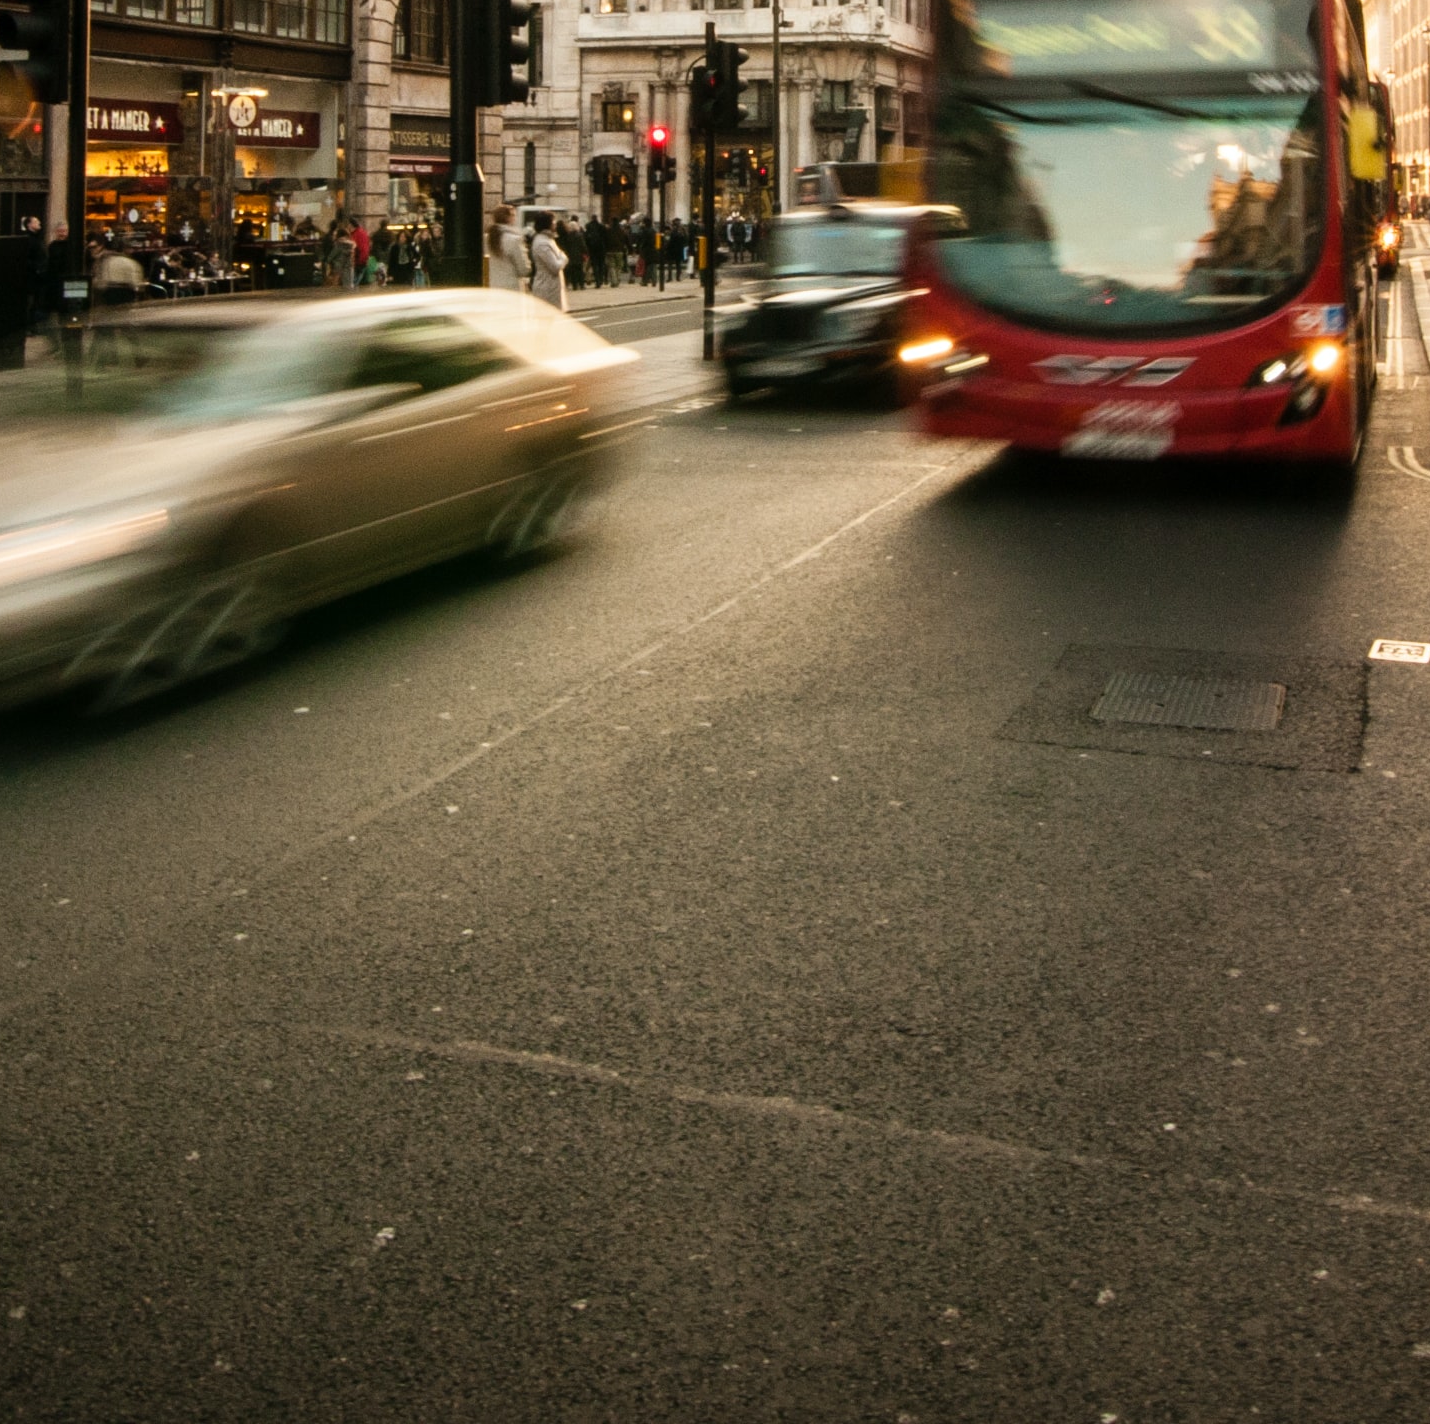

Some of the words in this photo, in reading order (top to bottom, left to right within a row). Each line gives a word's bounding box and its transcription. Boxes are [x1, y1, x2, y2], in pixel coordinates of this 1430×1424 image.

[87, 107, 100, 130] ET
[101, 108, 109, 130] A
[111, 109, 150, 132] MANGER
[261, 118, 293, 138] MANGER
[389, 130, 429, 147] ATISSERIE
[431, 133, 451, 147] VALE
